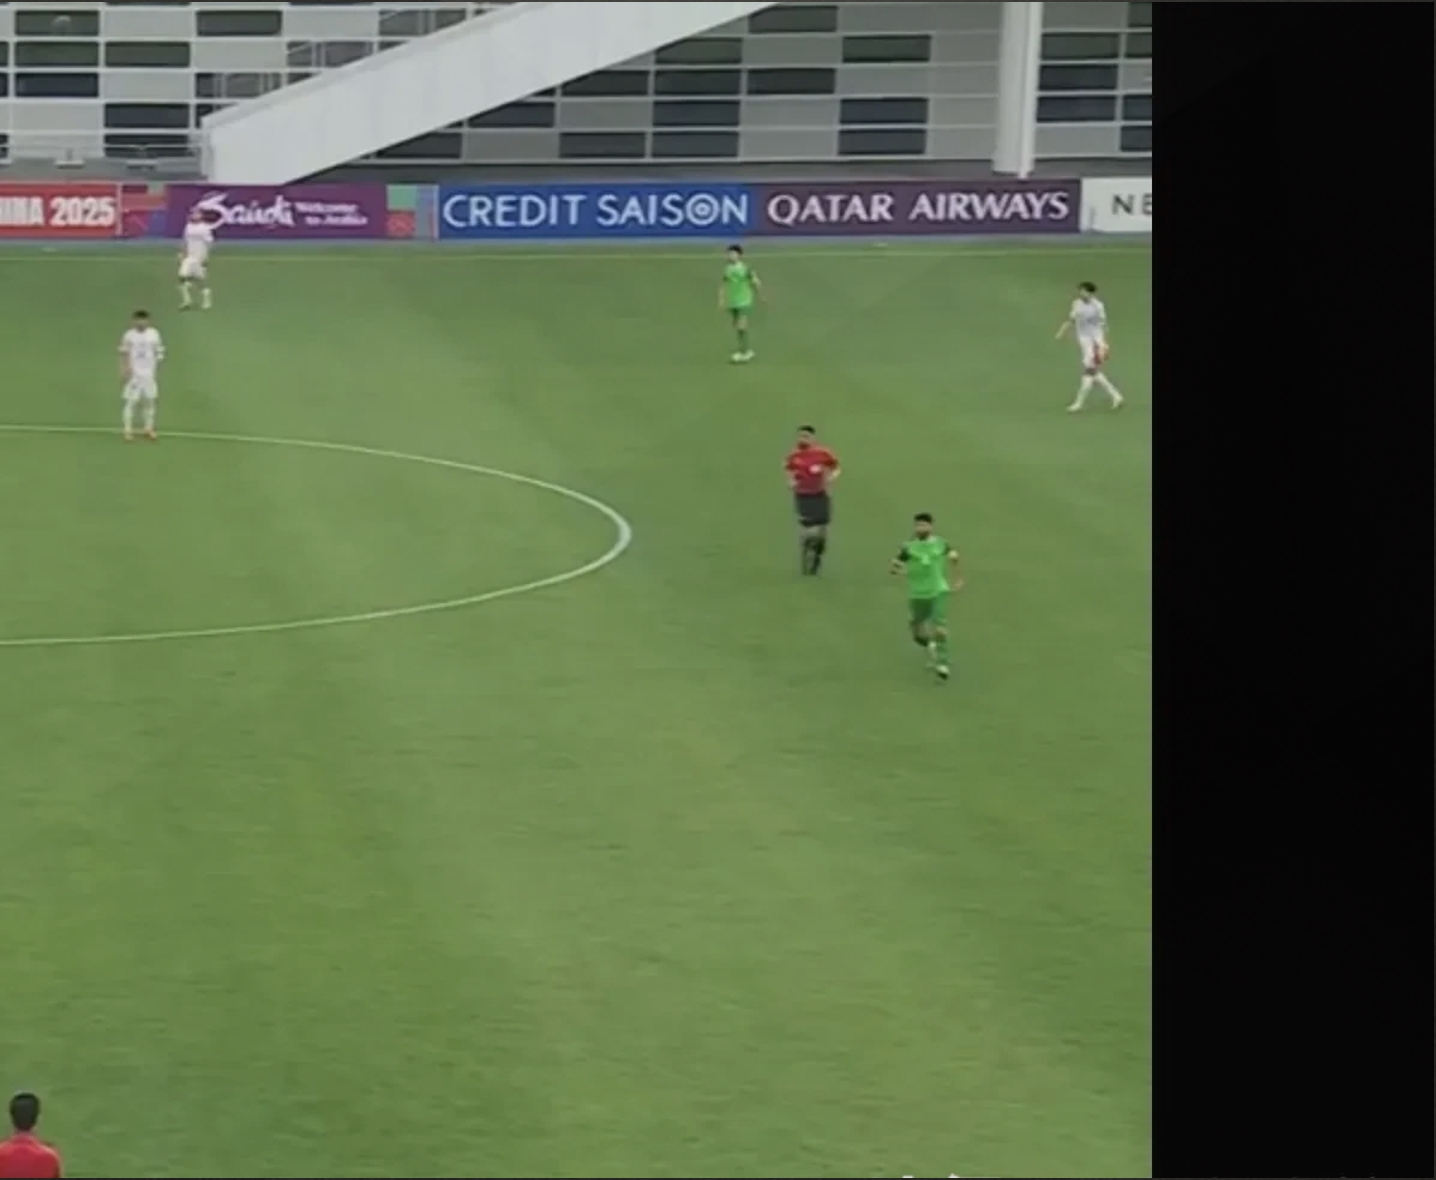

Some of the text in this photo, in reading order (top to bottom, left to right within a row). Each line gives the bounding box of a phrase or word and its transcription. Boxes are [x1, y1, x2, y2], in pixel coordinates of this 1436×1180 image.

[49, 195, 116, 227] 2025
[442, 193, 748, 227] CREDIT SAISON
[766, 191, 1069, 226] QATAR AIRWAYS
